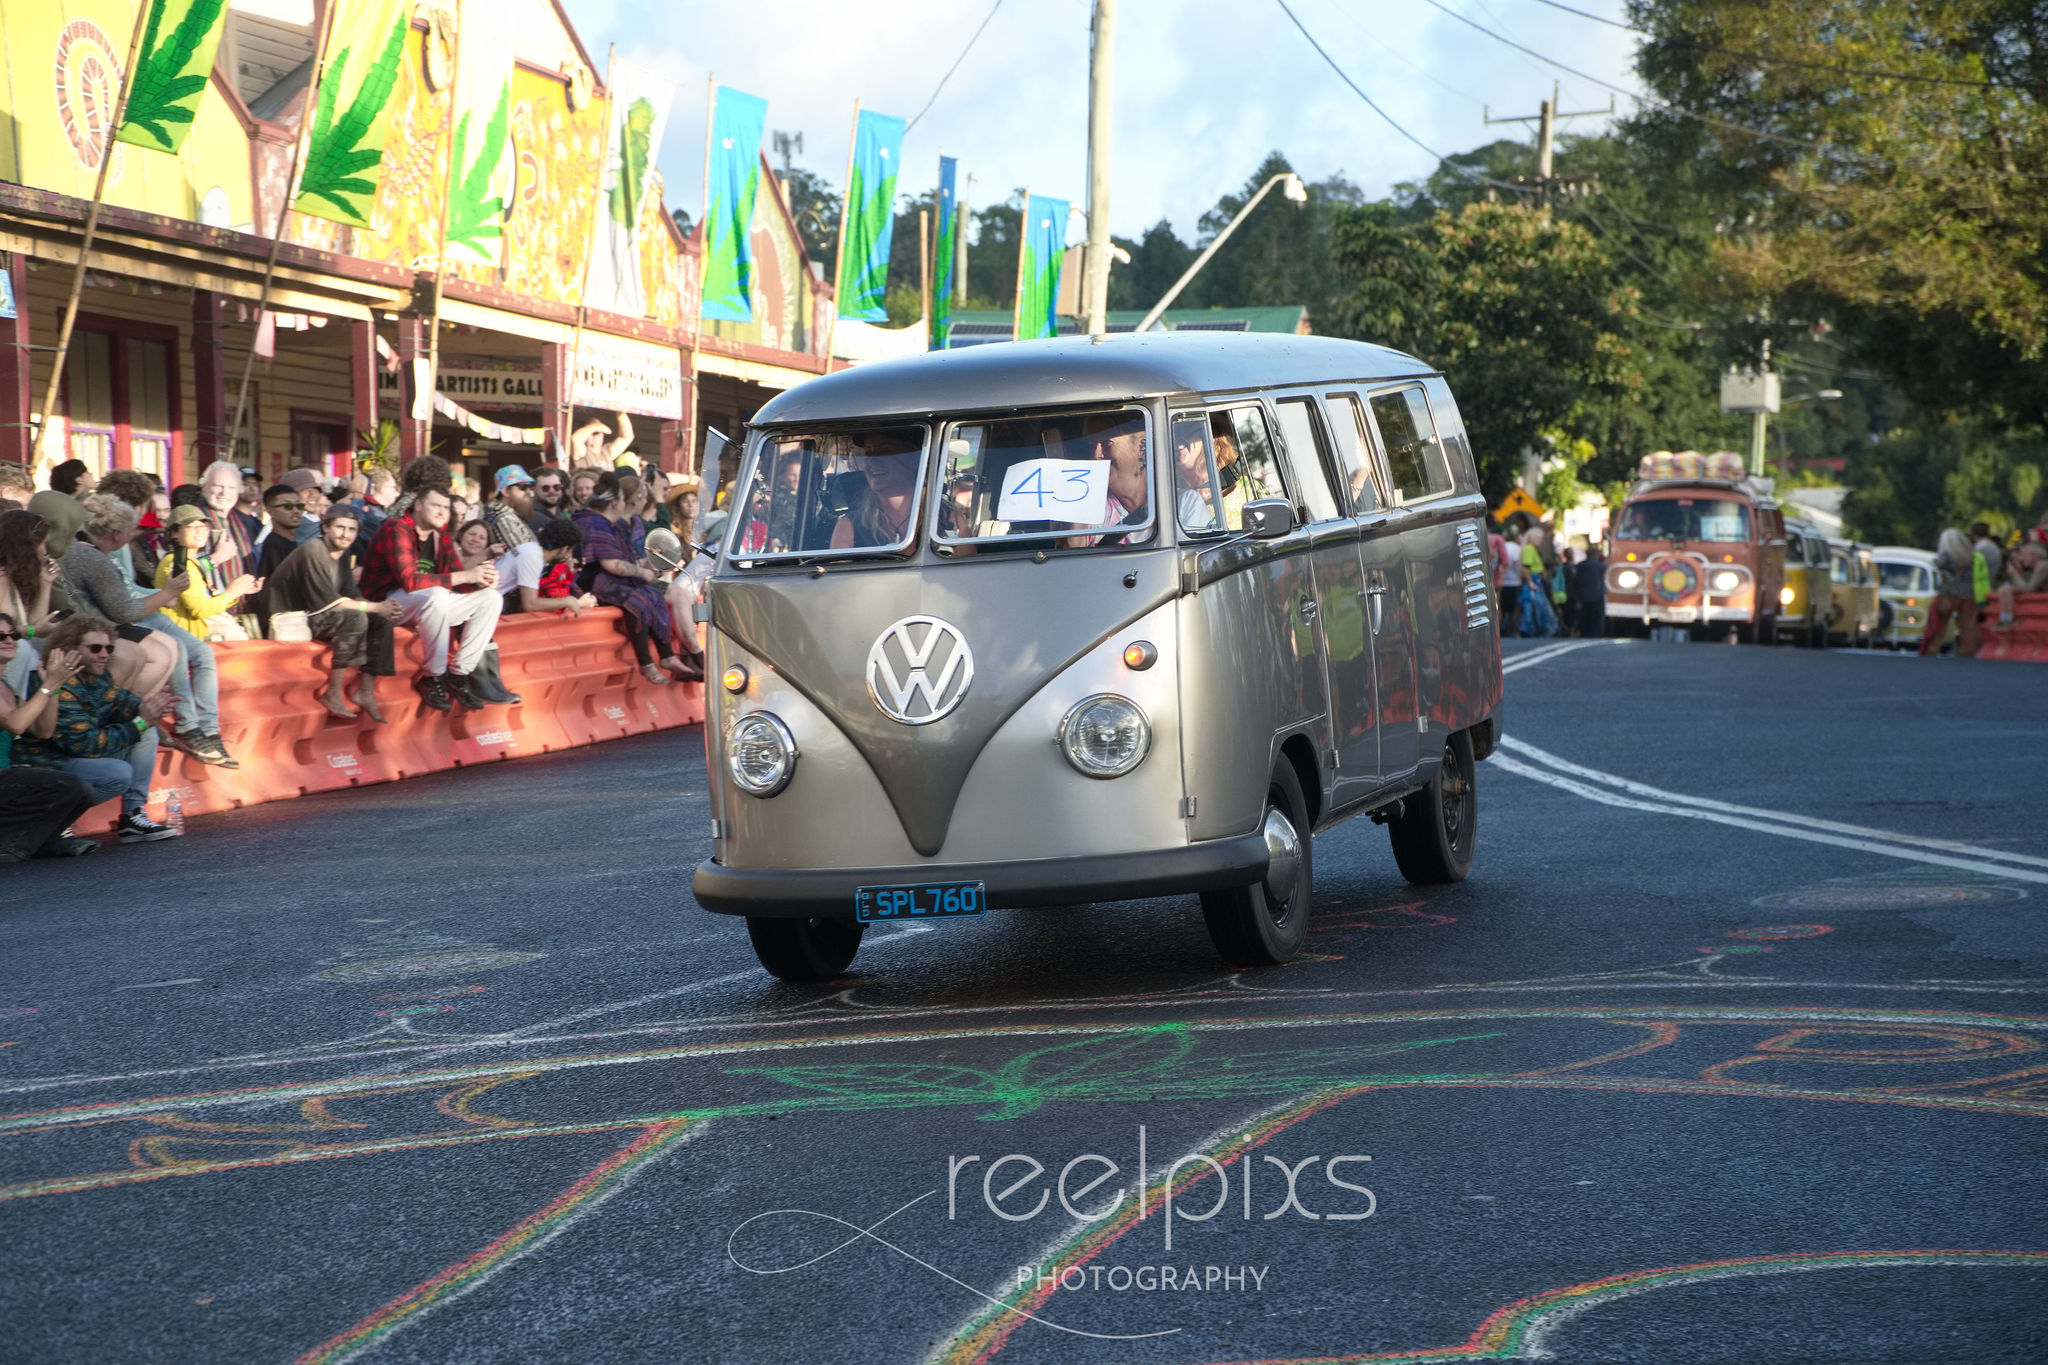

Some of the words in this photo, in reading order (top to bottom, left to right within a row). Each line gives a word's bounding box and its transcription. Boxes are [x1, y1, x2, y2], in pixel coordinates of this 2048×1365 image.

[436, 375, 498, 395] ARTISTS
[503, 377, 543, 396] GALL
[1010, 467, 1091, 508] 43
